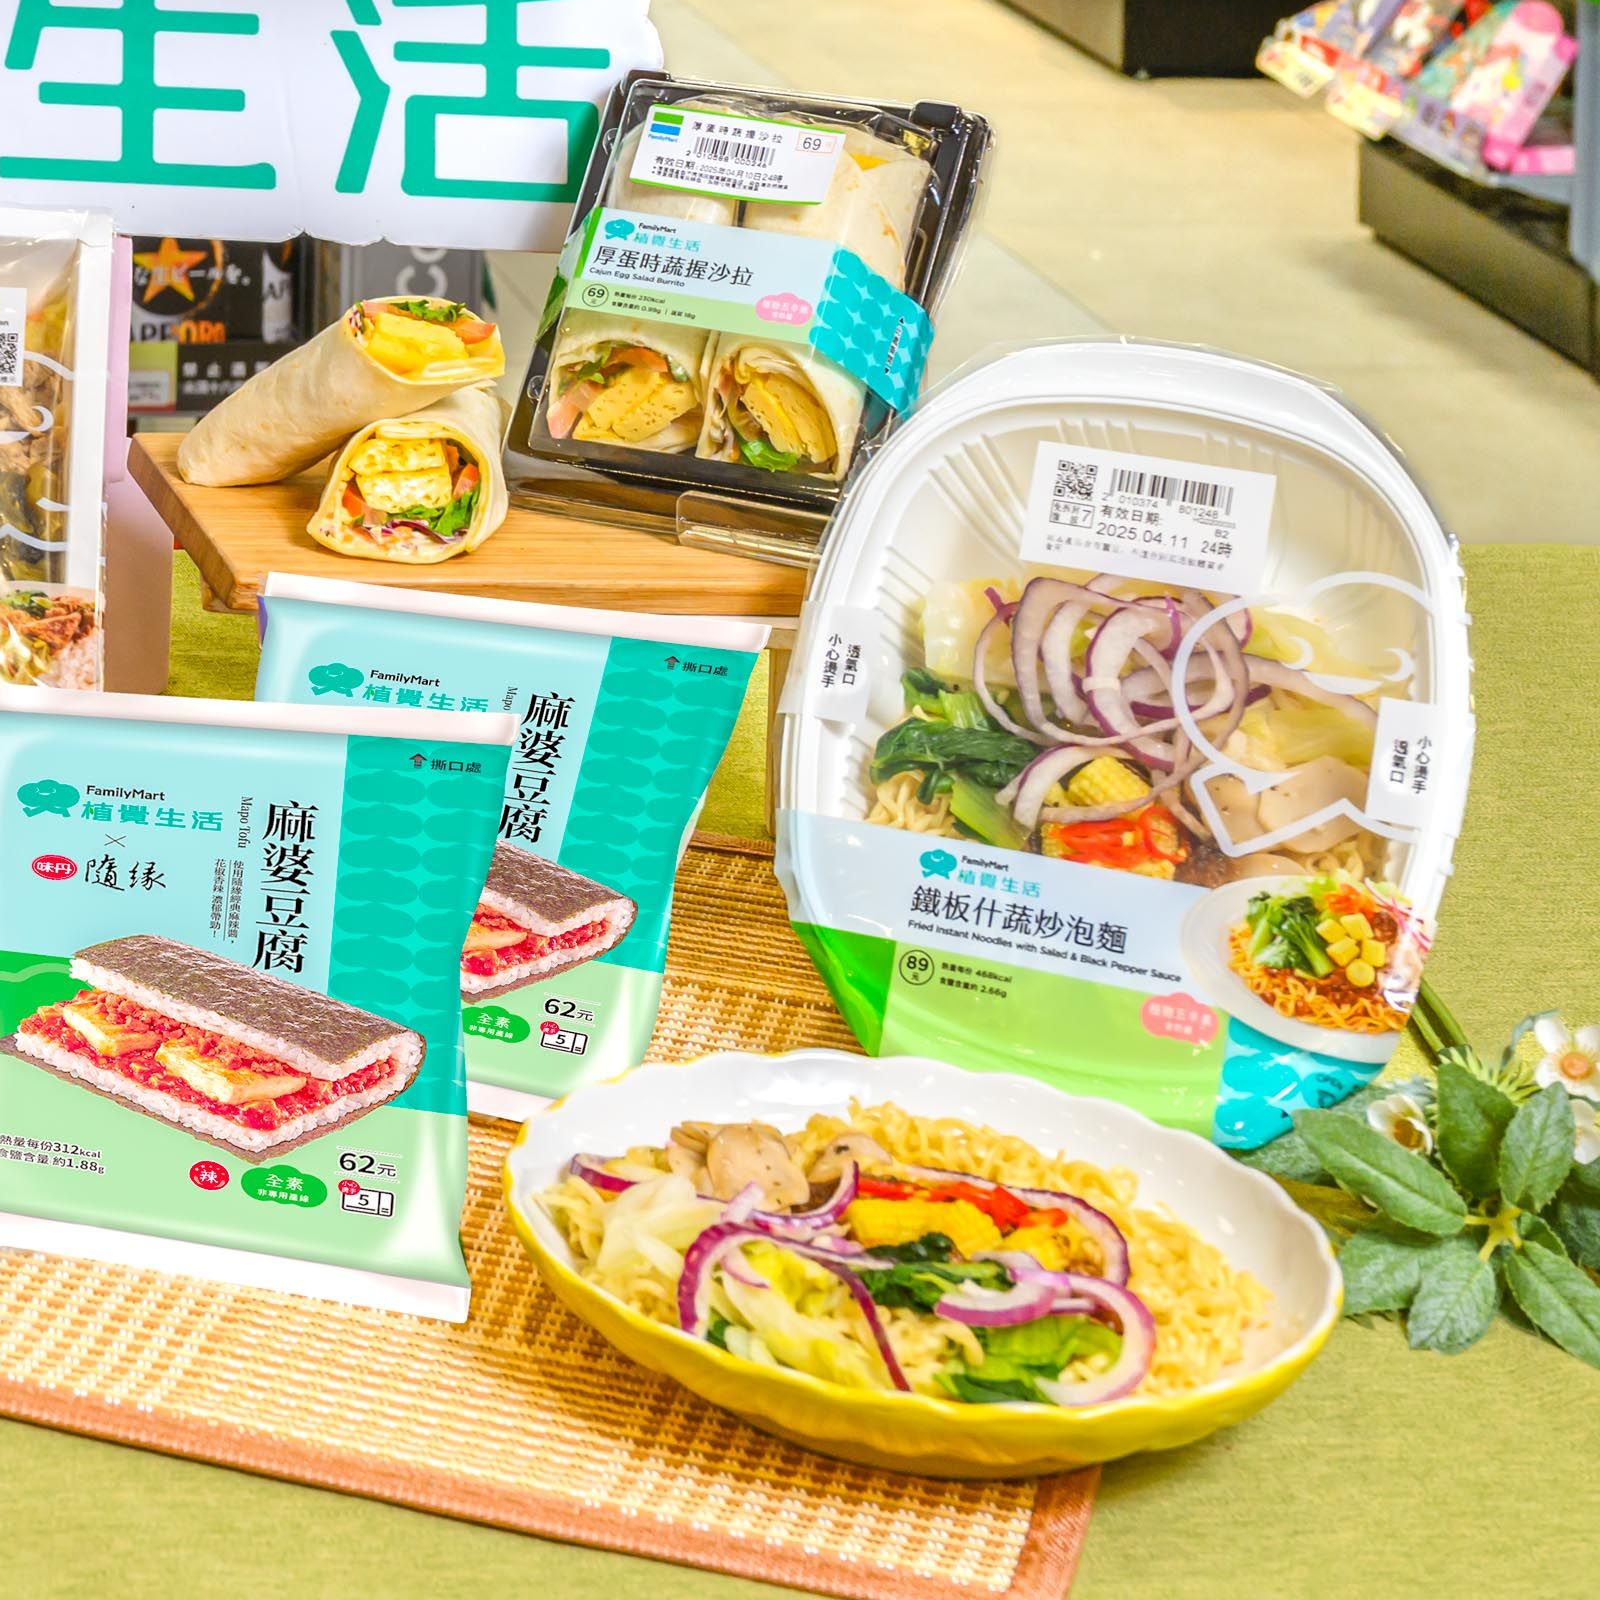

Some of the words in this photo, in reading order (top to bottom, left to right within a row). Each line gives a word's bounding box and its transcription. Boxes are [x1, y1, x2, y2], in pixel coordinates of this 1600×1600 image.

[802, 136, 823, 151] 69
[592, 245, 755, 288] 厚蛋時蔬握沙拉
[587, 287, 606, 299] 69
[656, 277, 686, 288] Burrito
[1096, 522, 1190, 549] 2025.04.11
[369, 669, 441, 688] FamilyMart
[681, 660, 729, 677] 撕口處
[362, 682, 489, 713] 植覺生活
[502, 686, 518, 711] Mapo
[430, 757, 482, 776] 撕口處
[499, 692, 576, 845] 麻婆豆腐
[85, 784, 166, 802] FamilyMart
[80, 800, 224, 832] 植覺生活
[238, 795, 254, 824] Mapo
[236, 825, 252, 850] Tofu
[35, 860, 73, 876] 味丹
[84, 853, 167, 893] 隨緣
[961, 855, 1010, 873] FamilyMart
[251, 799, 319, 975] 麻婆豆腐
[909, 884, 1129, 956] 鐵板什蔬炒泡麵
[907, 919, 934, 933] Fried
[935, 926, 969, 941] Instant
[971, 931, 1013, 949] Noodles
[1039, 945, 1067, 959] Salad
[1080, 954, 1108, 969] Black
[1110, 960, 1148, 977] Pepper
[1150, 968, 1182, 983] Sauce
[905, 955, 929, 973] 89
[476, 1010, 512, 1031] 全素
[544, 998, 595, 1023] 62元
[0, 1134, 102, 1160] 熱量每份312kcal
[338, 1151, 397, 1177] 62元
[265, 1173, 305, 1192] 全素
